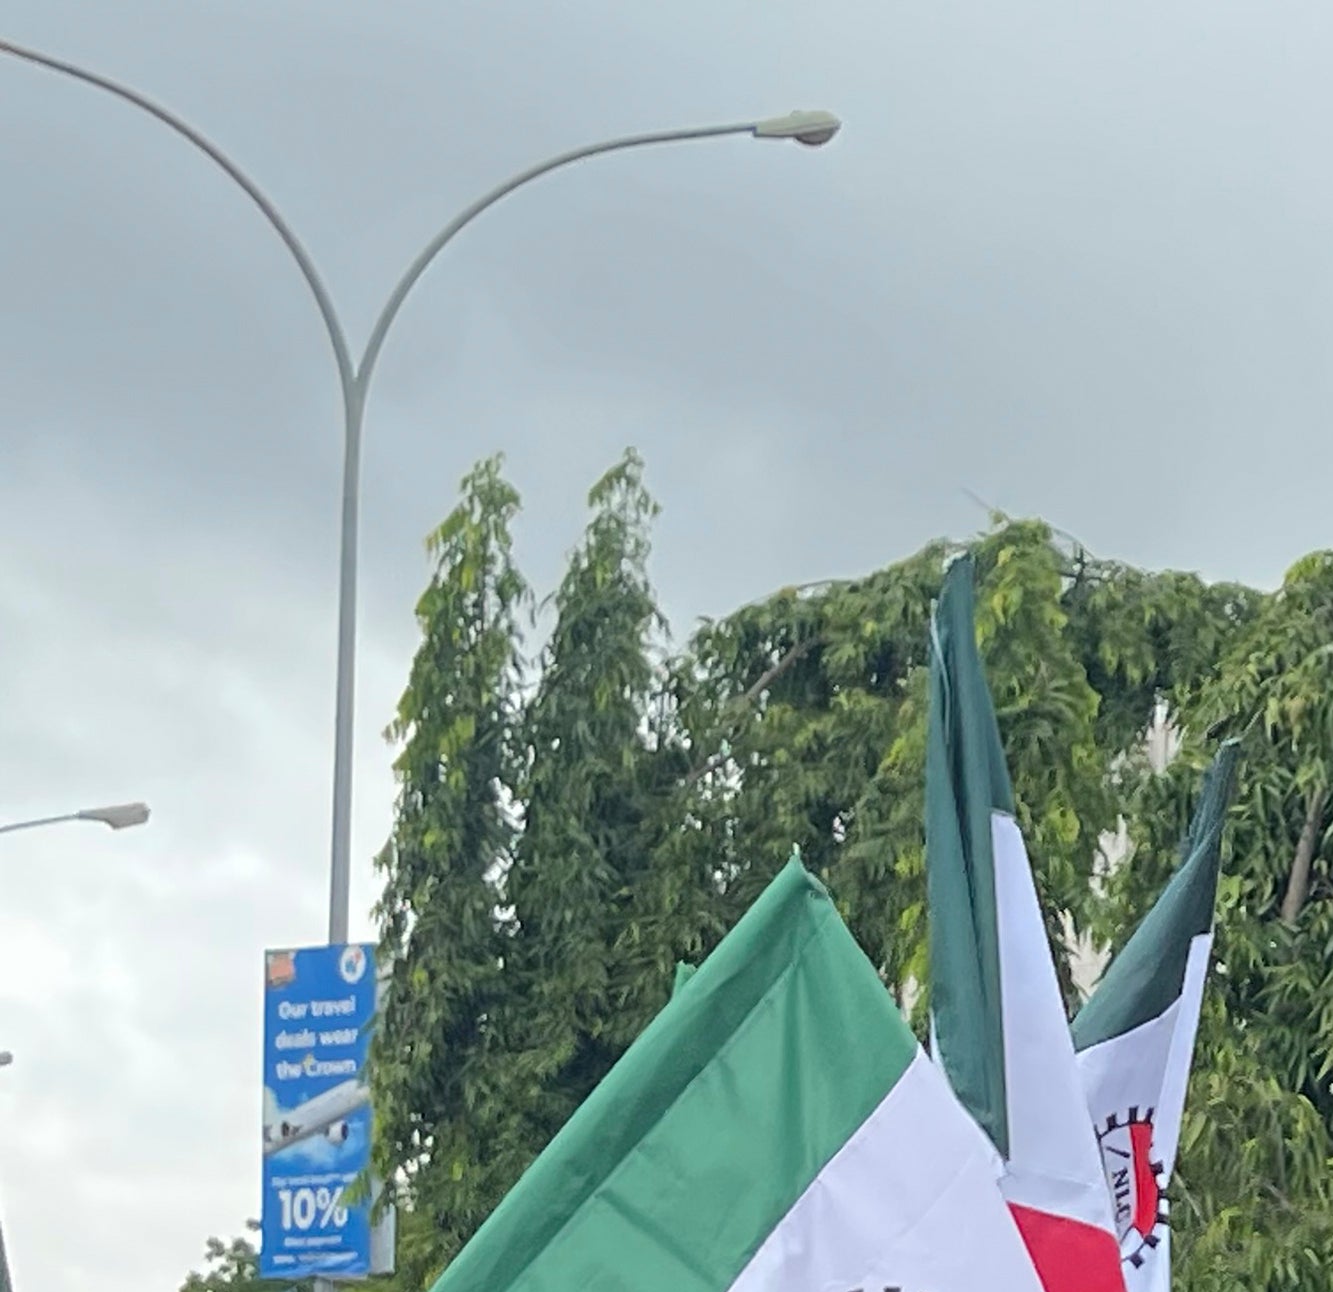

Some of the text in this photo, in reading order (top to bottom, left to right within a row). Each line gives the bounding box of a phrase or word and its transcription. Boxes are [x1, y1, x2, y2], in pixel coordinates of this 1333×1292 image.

[279, 1001, 308, 1020] Our
[276, 1060, 302, 1080] the
[279, 1186, 348, 1230] 10%
